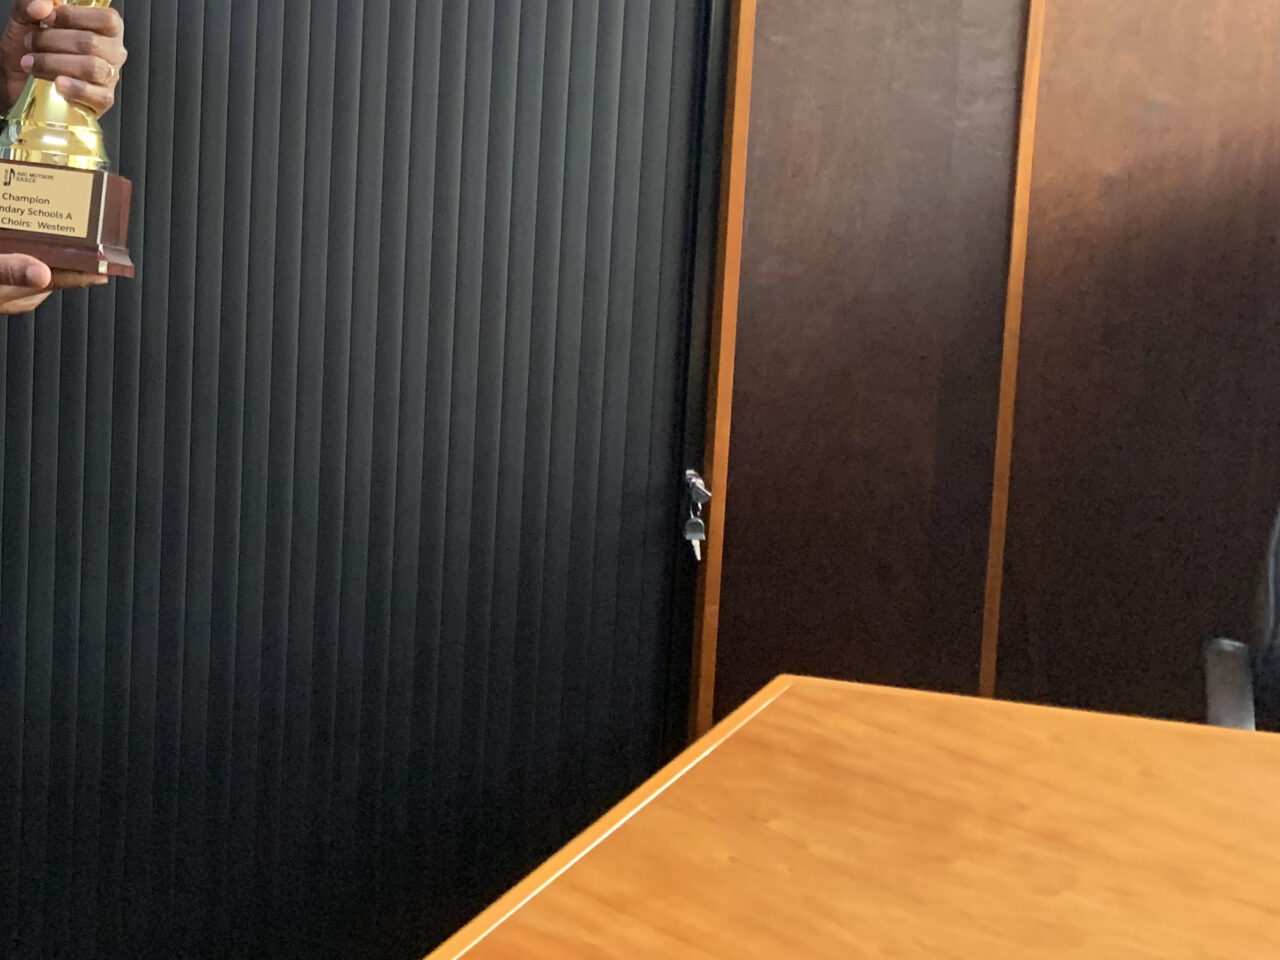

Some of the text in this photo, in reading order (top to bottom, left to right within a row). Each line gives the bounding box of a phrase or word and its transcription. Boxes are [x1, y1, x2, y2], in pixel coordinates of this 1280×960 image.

[2, 192, 50, 205] Champion
[27, 208, 63, 219] Schools
[65, 212, 72, 220] A
[1, 217, 32, 228] Choirs:
[37, 221, 76, 233] Western
